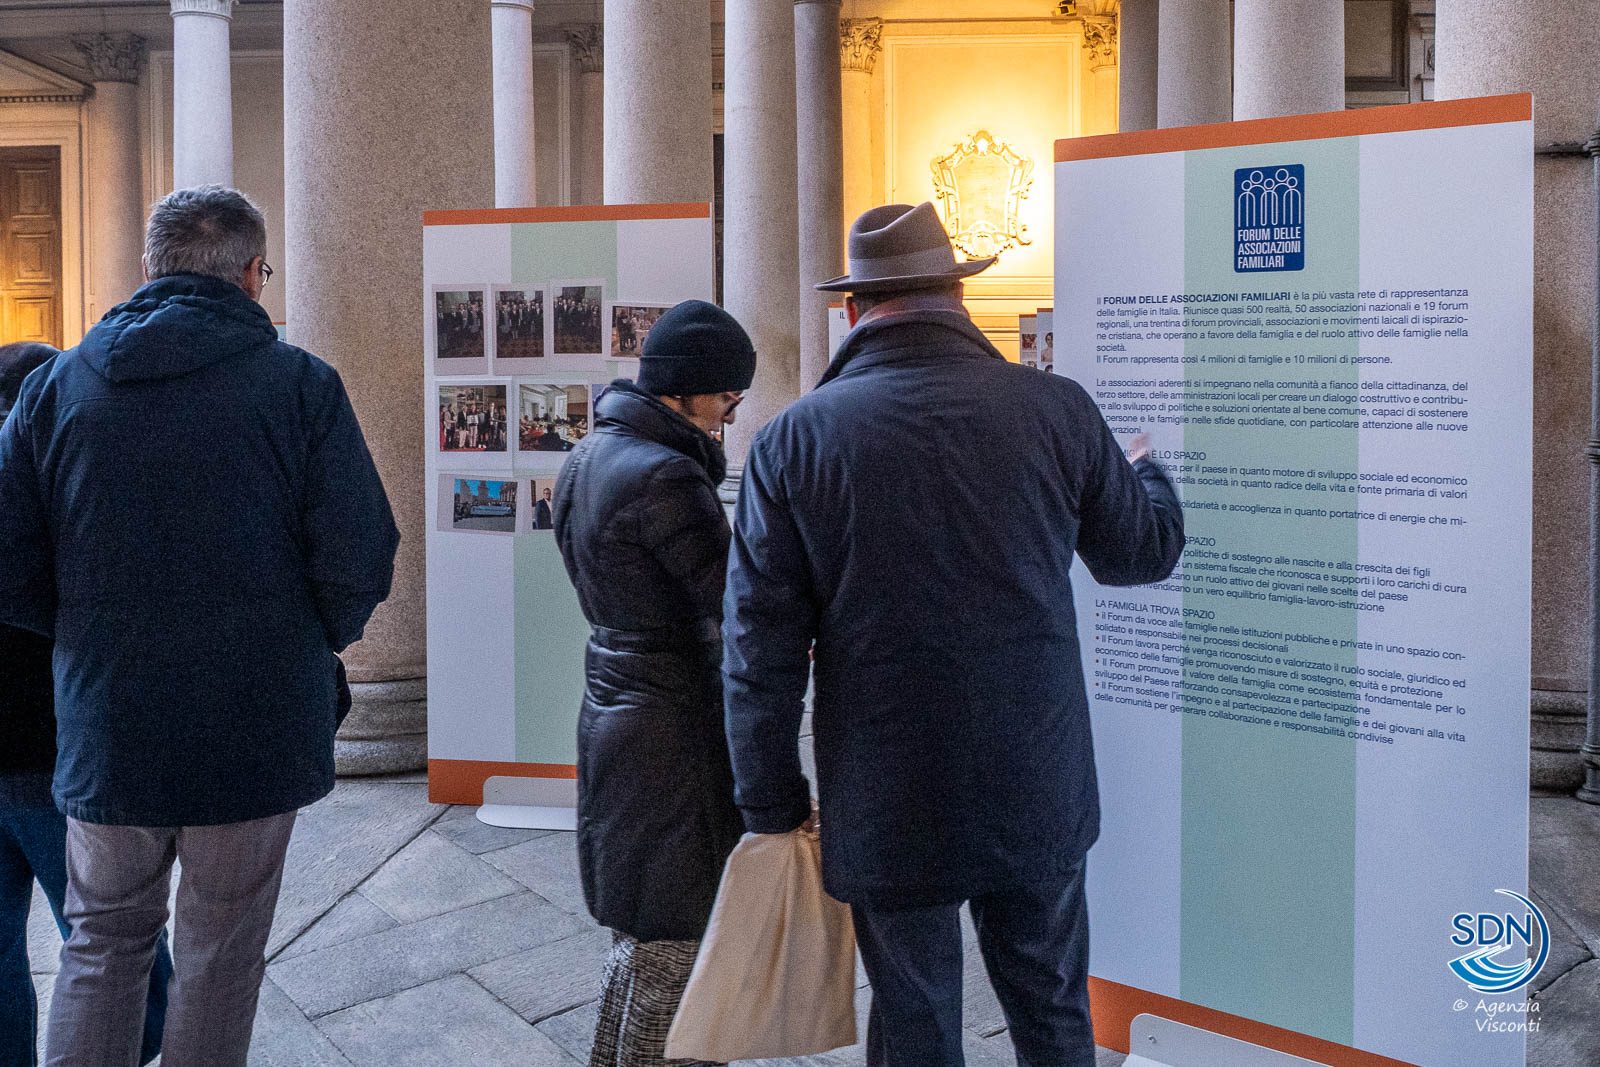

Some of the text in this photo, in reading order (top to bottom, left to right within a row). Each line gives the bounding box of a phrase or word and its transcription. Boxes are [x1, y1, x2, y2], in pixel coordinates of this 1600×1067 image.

[1238, 227, 1301, 242] FORUM DELLE
[1238, 241, 1301, 255] ASSOCIAZIONI
[1238, 256, 1284, 269] FAMILIARI
[1103, 296, 1136, 304] FORUM
[1138, 295, 1168, 304] DELLE
[1170, 293, 1238, 303] ASSOCIAZIONI
[1240, 292, 1290, 301] FAMILIARI
[1301, 291, 1309, 300] la
[1312, 290, 1326, 302] più
[1329, 291, 1354, 299] vasta
[1357, 290, 1376, 298] rete
[1378, 289, 1387, 298] di
[1390, 288, 1468, 300] rappresentanza
[1096, 308, 1115, 316] delle
[1117, 307, 1148, 318] famiglie
[1149, 307, 1157, 315] in
[1158, 307, 1180, 315] Italia.
[1182, 306, 1218, 314] Riunisce
[1220, 305, 1244, 316] quasi
[1246, 305, 1263, 313] 500
[1265, 304, 1292, 314] realtà,
[1295, 304, 1307, 312] 50
[1309, 303, 1366, 312] associazioni
[1368, 302, 1411, 311] nazionali
[1423, 301, 1436, 310] 19
[1438, 301, 1468, 310] forum
[1096, 319, 1131, 330] regionali,
[1149, 319, 1180, 327] trentina
[1182, 318, 1189, 327] di
[1191, 318, 1216, 326] forum
[1217, 317, 1263, 328] provinciali,
[1265, 316, 1320, 325] associazioni
[1330, 315, 1379, 324] movimenti
[1381, 315, 1408, 324] laicali
[1410, 314, 1420, 324] di
[1422, 314, 1467, 326] ispirazio-
[1096, 343, 1126, 351] società.
[1130, 355, 1179, 365] rappresenta
[1180, 354, 1198, 363] così
[1208, 354, 1235, 363] milioni
[1237, 354, 1246, 363] di
[1248, 354, 1282, 365] famiglie
[1293, 355, 1305, 363] 10
[1307, 354, 1337, 363] milioni
[1339, 354, 1348, 363] di
[1350, 356, 1392, 365] persone.
[1108, 378, 1156, 386] associazioni
[1158, 378, 1191, 387] aderenti
[1193, 379, 1201, 387] si
[1203, 379, 1251, 389] impegnano
[1253, 379, 1274, 388] nella
[1276, 380, 1318, 388] comunità
[1329, 380, 1358, 389] fianco
[1360, 380, 1383, 389] della
[1386, 381, 1449, 391] cittadinanza,
[1452, 381, 1468, 391] del
[1106, 415, 1137, 423] persone
[1147, 414, 1155, 422] le
[1157, 414, 1189, 425] famiglie
[1191, 415, 1211, 424] nelle
[1214, 416, 1235, 424] sfide
[1237, 417, 1286, 427] quotidiane,
[1309, 418, 1359, 429] particolare
[1362, 420, 1413, 429] attenzione
[1415, 421, 1433, 430] alle
[1158, 450, 1171, 459] LO
[1173, 451, 1206, 460] SPAZIO
[1179, 465, 1193, 474] per
[1201, 466, 1227, 474] paese
[1229, 465, 1237, 474] in
[1239, 467, 1270, 476] quanto
[1272, 468, 1304, 477] motore
[1306, 469, 1315, 478] di
[1317, 470, 1357, 481] sviluppo
[1359, 472, 1393, 481] sociale
[1395, 473, 1408, 482] ed
[1411, 475, 1467, 485] economico
[1183, 548, 1219, 558] politiche
[1221, 551, 1229, 560] di
[1231, 554, 1272, 564] sostegno
[1274, 556, 1290, 565] alle
[1292, 558, 1325, 568] nascite
[1336, 561, 1352, 570] alla
[1354, 564, 1392, 573] crescita
[1395, 565, 1410, 575] dei
[1413, 567, 1430, 578] figli
[1226, 589, 1266, 600] equilibrio
[1268, 591, 1384, 610] famiglia-lavoro-istruzione
[1095, 599, 1215, 619] LA FAMIGLIA TROVA SPAZIO
[1095, 623, 1126, 633] solidato
[1135, 628, 1187, 640] responsabile
[1188, 634, 1201, 642] nei
[1203, 636, 1239, 646] processi
[1241, 639, 1288, 652] decisionali
[1095, 647, 1138, 658] economico
[1140, 651, 1160, 661] delle
[1161, 653, 1193, 666] famiglie
[1195, 660, 1255, 673] promuovendo
[1257, 667, 1287, 677] misure
[1290, 670, 1298, 679] di
[1300, 673, 1346, 686] sostegno,
[1348, 680, 1379, 690] equità
[1390, 685, 1443, 698] protezione
[1095, 669, 1127, 681] sviluppo
[1129, 673, 1142, 682] del
[1143, 676, 1169, 686] Paese
[1171, 680, 1218, 693] rafforzando
[1220, 688, 1291, 703] consapevolezza
[1301, 699, 1370, 714] partecipazione
[1094, 691, 1113, 702] delle
[1115, 696, 1152, 707] comunità
[1153, 702, 1167, 710] per
[1169, 704, 1206, 715] generare
[1208, 710, 1271, 725] collaborazione
[1281, 721, 1345, 736] responsabilità
[1347, 731, 1393, 744] condivise
